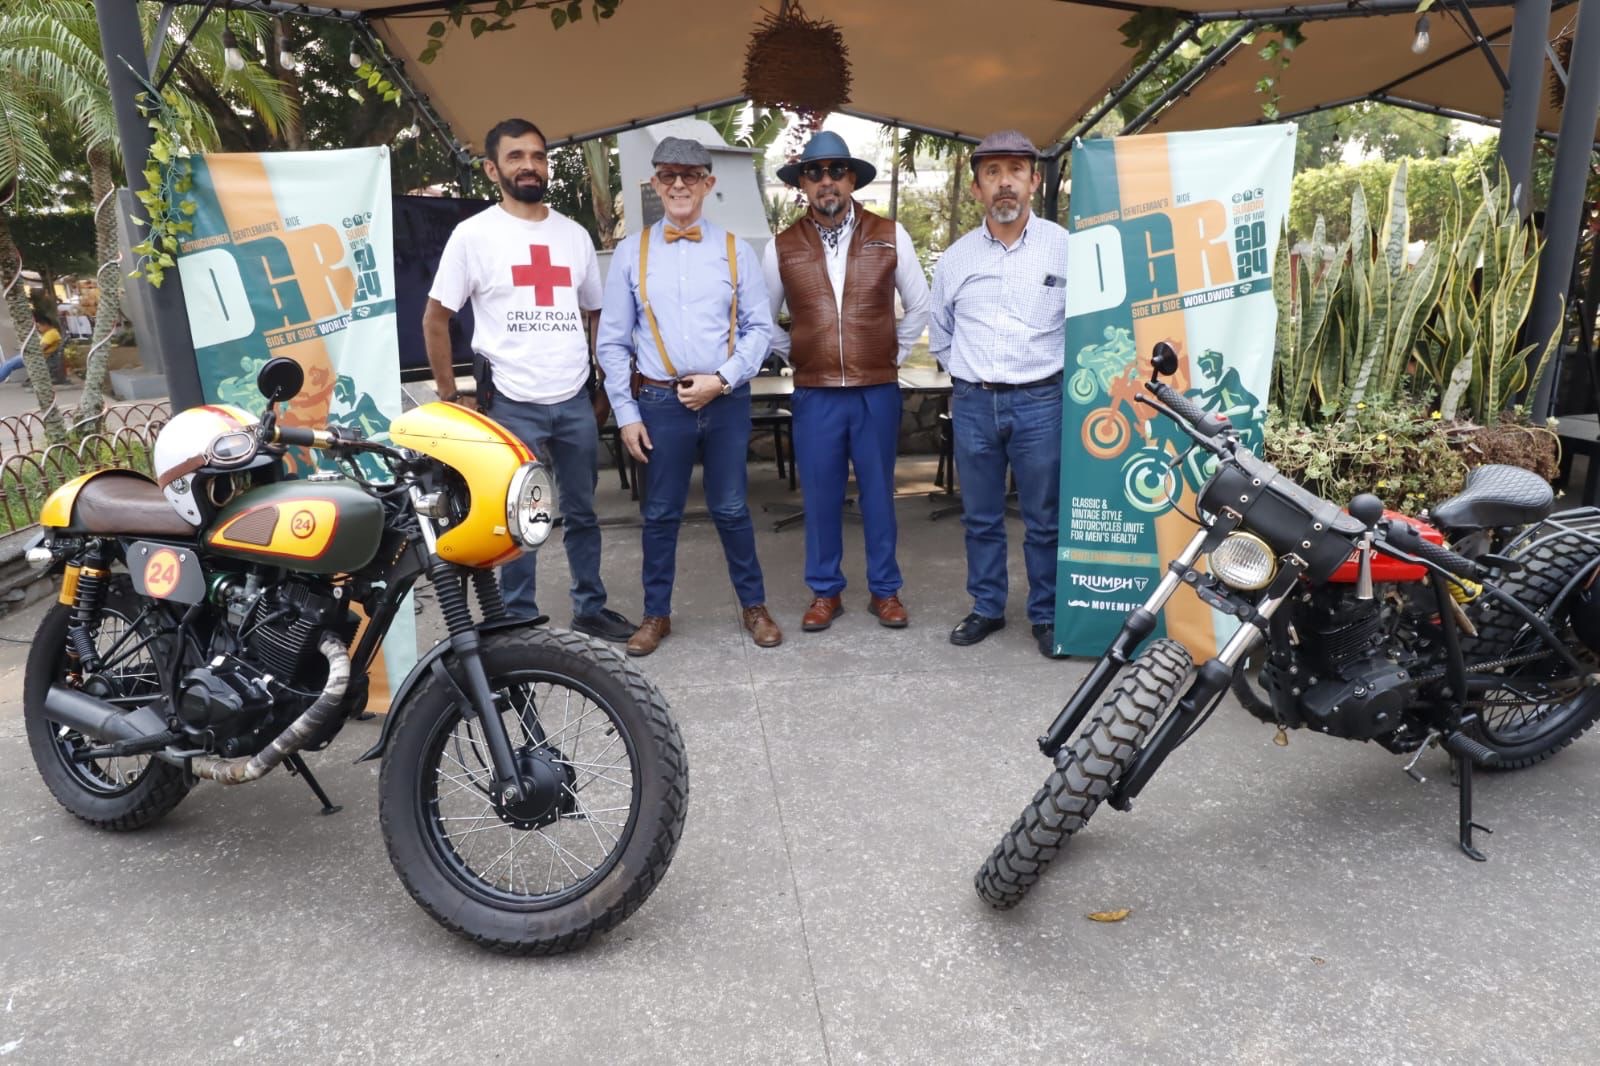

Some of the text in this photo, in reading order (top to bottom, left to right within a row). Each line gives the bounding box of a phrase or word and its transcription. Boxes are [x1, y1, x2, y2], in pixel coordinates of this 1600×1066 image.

[1176, 192, 1191, 203] RIDE
[233, 222, 279, 240] GENTLEMAN'S
[284, 215, 301, 226] RIDE
[1132, 287, 1235, 318] SIDE BY SIDE WORLDWIDE
[506, 311, 577, 321] CRUZ ROJA
[506, 322, 578, 332] MEXICANA
[265, 335, 286, 347] SIDE
[286, 331, 297, 343] BY
[297, 326, 318, 340] SIDE
[1072, 497, 1108, 509] CLASSIC &
[1071, 508, 1123, 521] VINTAGE STYLE
[294, 517, 312, 532] 24
[1071, 519, 1145, 533] MOTORCYCLES UNITE
[1070, 530, 1137, 544] FOR MEN'S HEALTH
[148, 563, 176, 584] 24
[1070, 574, 1133, 593] TRIUMPH
